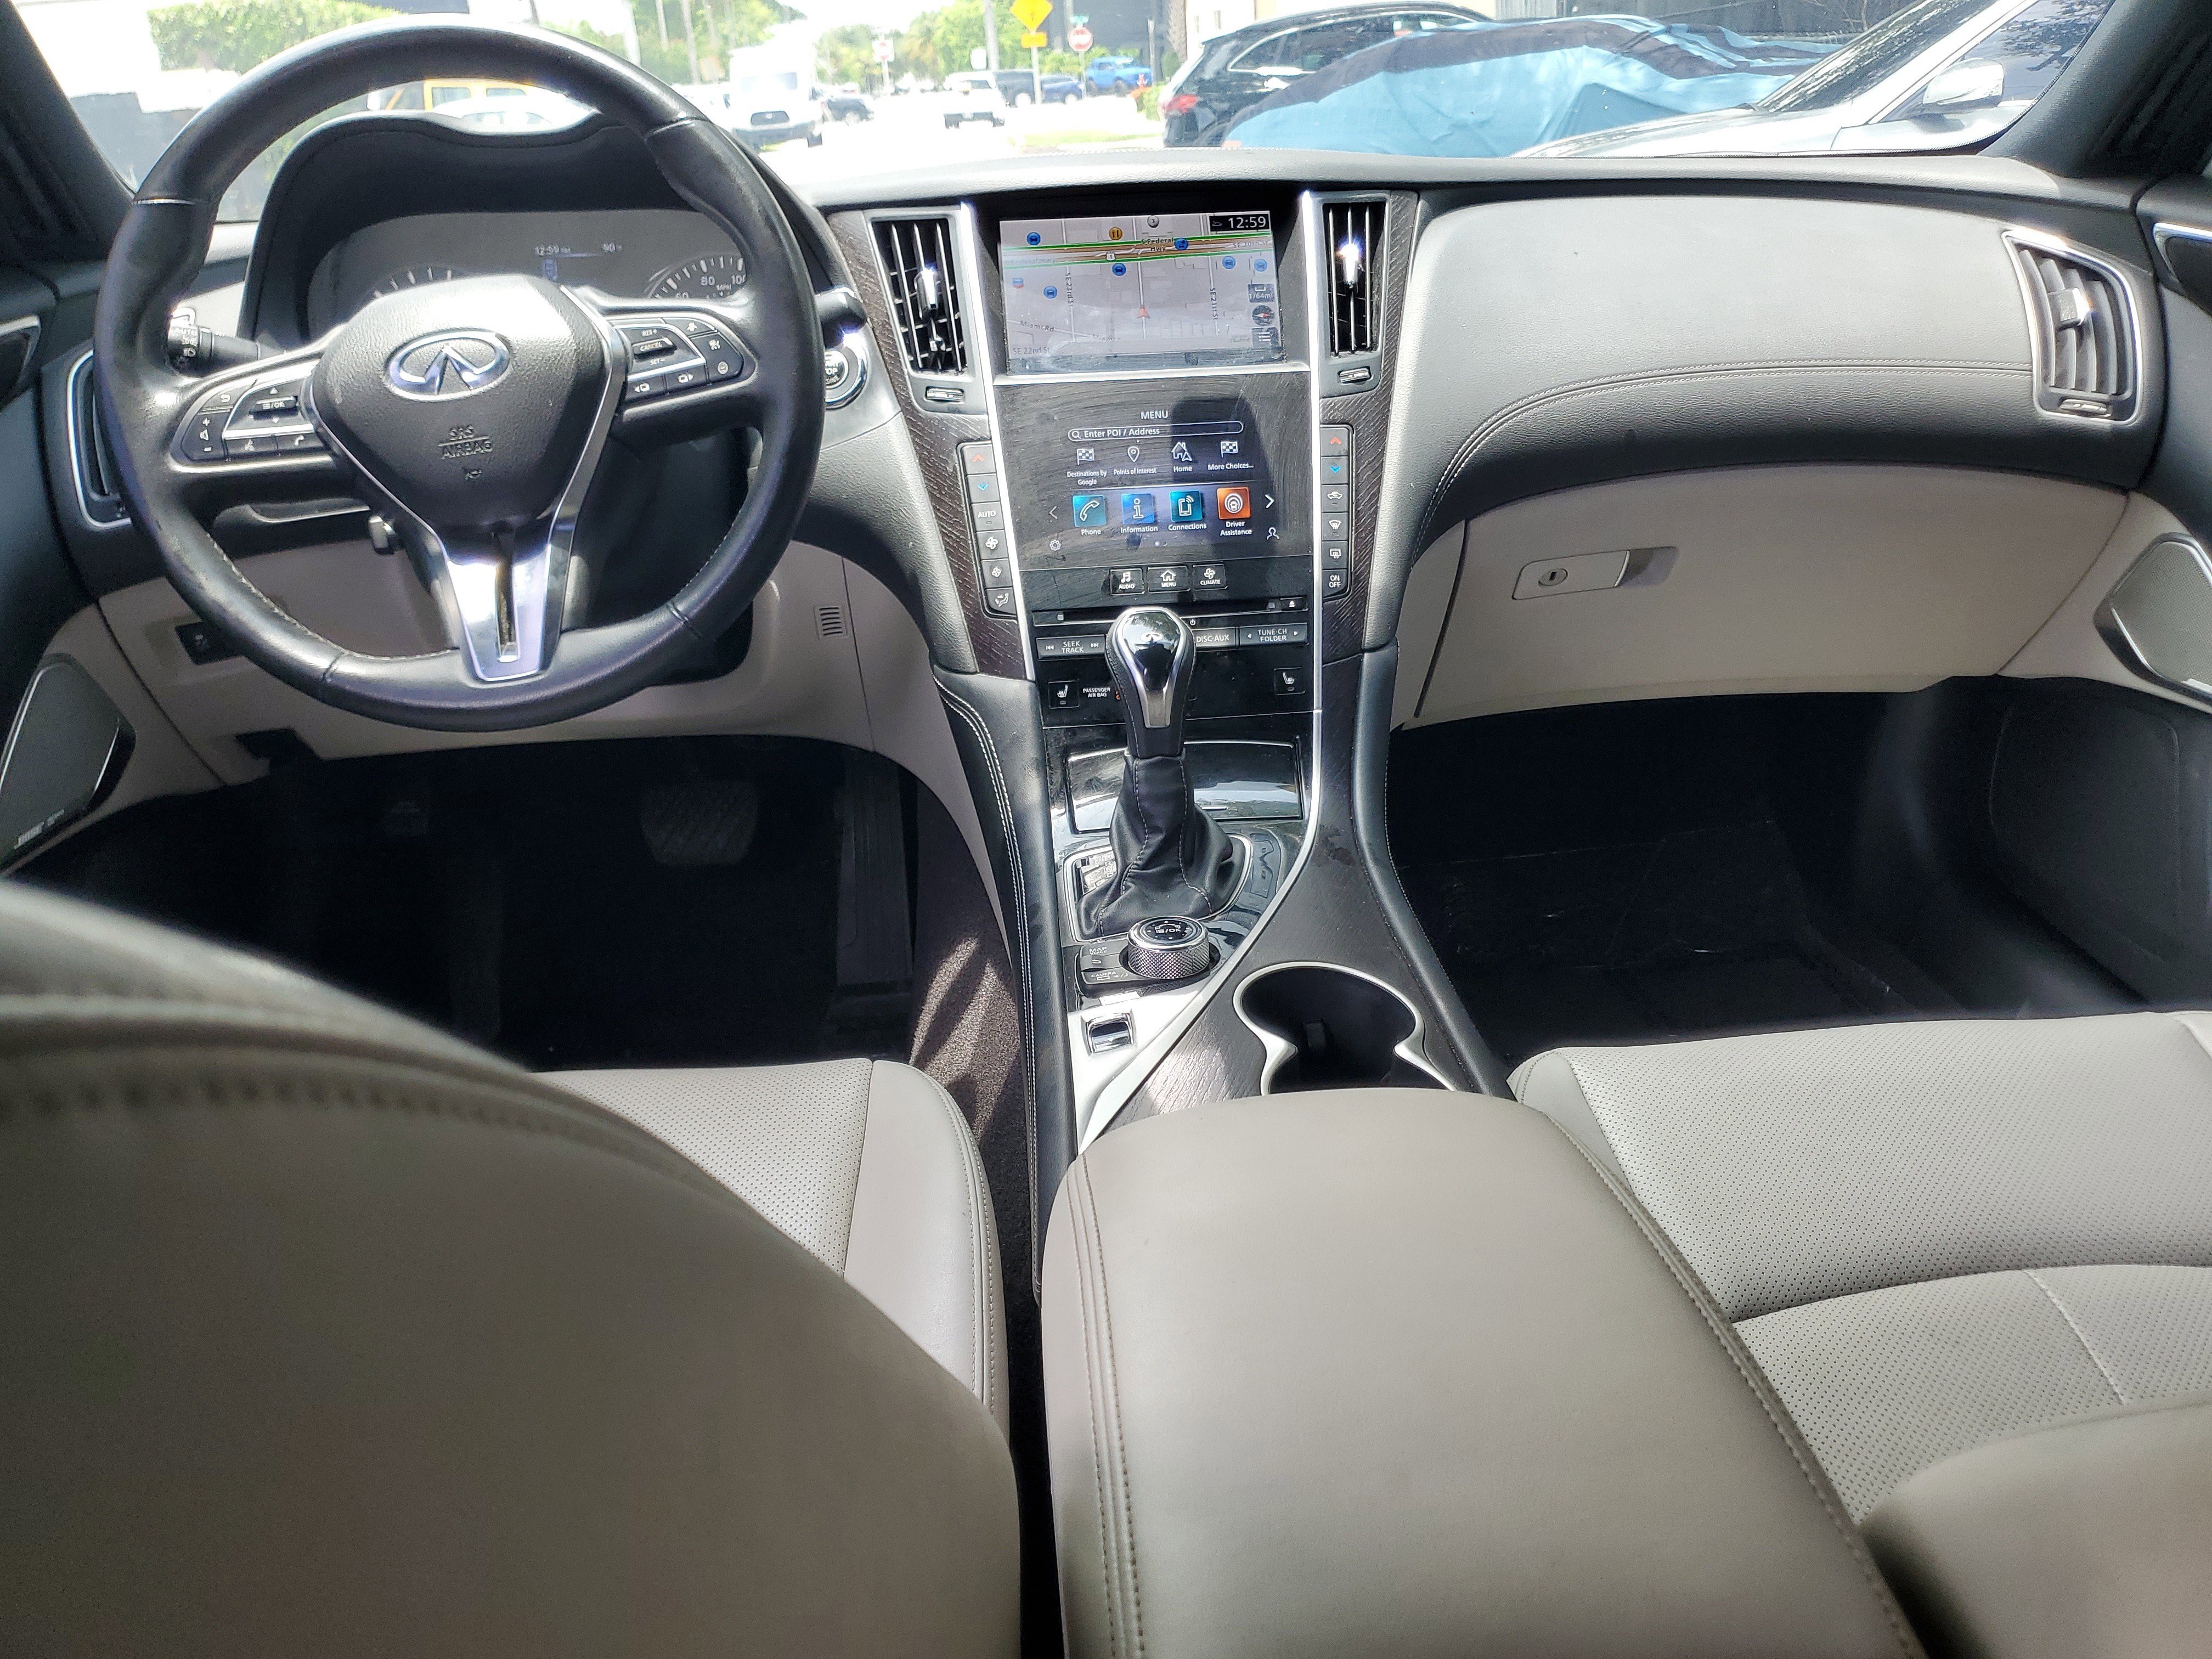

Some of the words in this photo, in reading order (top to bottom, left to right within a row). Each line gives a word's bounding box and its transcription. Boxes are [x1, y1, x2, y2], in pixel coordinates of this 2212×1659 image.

[1228, 216, 1267, 229] 12:59
[701, 275, 715, 286] 80
[1020, 320, 1043, 330] Miami
[1023, 346, 1042, 354] 22nd
[1140, 410, 1169, 420] MENU
[1128, 428, 1160, 436] Address
[977, 510, 996, 518] AUTO
[1120, 526, 1159, 534] Information
[1167, 523, 1207, 531] Connections
